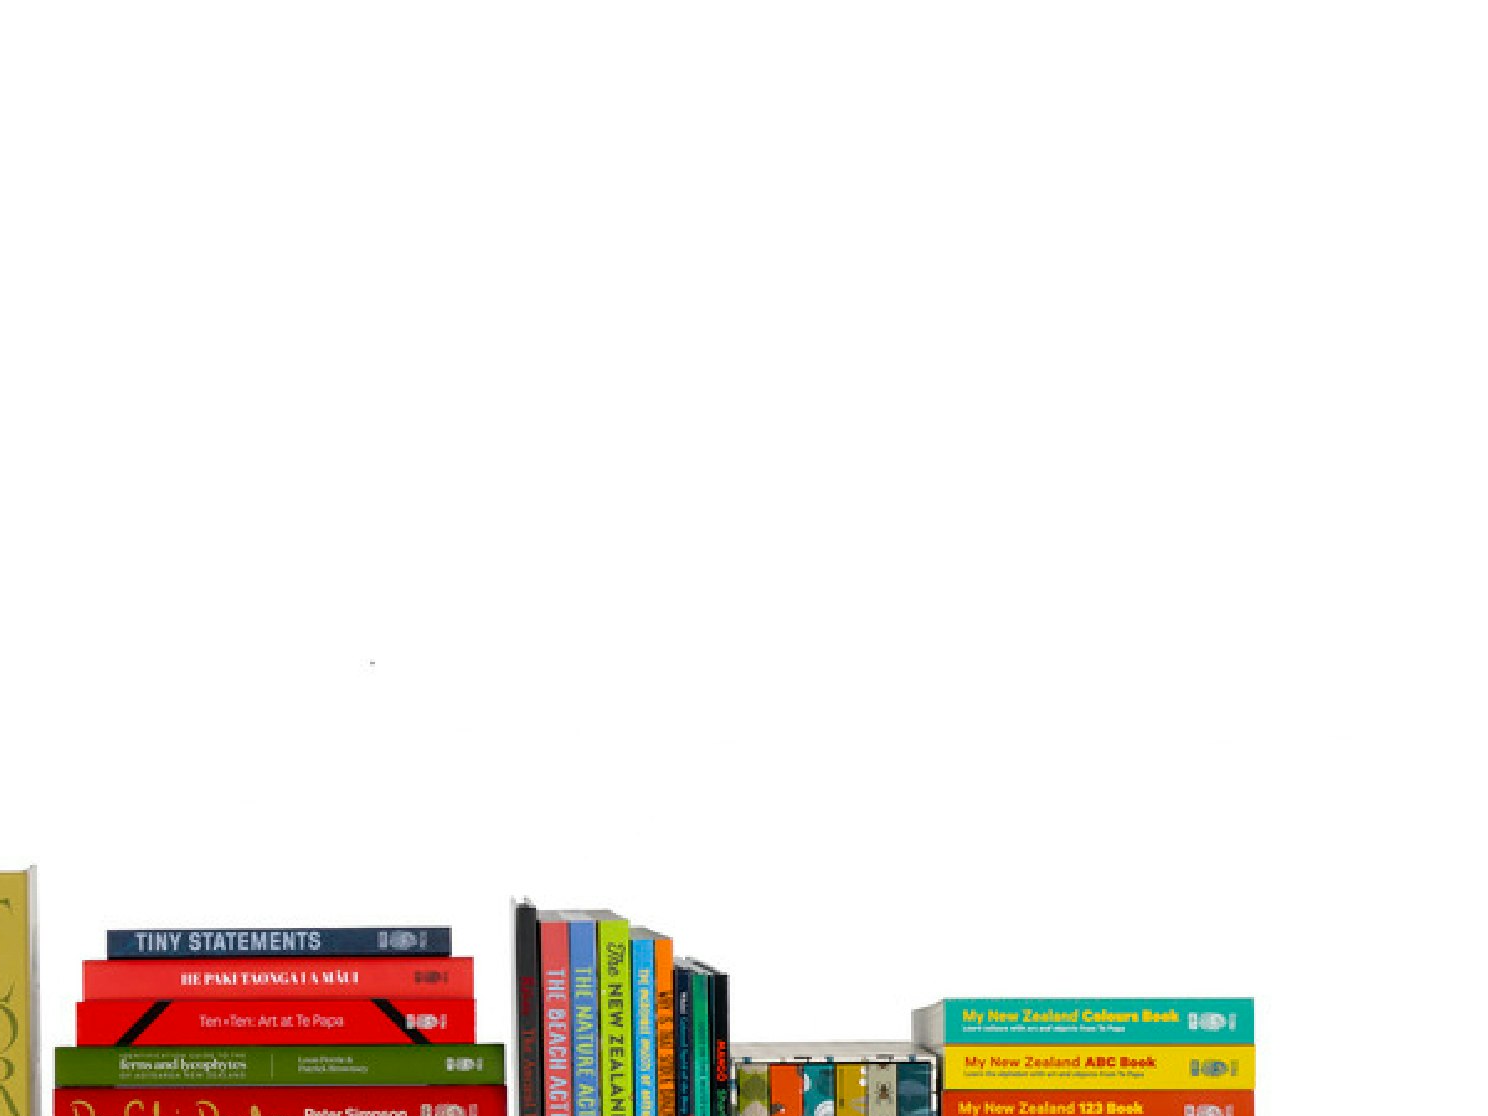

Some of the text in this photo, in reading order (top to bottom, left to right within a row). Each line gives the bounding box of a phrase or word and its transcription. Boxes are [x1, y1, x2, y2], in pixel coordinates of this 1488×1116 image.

[135, 931, 321, 951] TINY STATEMENTS
[606, 942, 627, 977] The
[180, 972, 202, 986] HE
[204, 972, 237, 986] PAKI
[241, 972, 299, 986] TAONGA
[545, 969, 567, 1002] THE
[575, 966, 593, 998] THE
[607, 984, 625, 1028] NEW
[962, 1009, 1179, 1023] My New Zealand Colours Book
[199, 1013, 344, 1030] Ten Art at Te Papa
[548, 1008, 568, 1069] BEACH
[576, 1006, 596, 1076] NATURE
[965, 1056, 1156, 1069] My New Zealand ABC Book
[958, 1101, 1144, 1115] My New Zealand 123 Book
